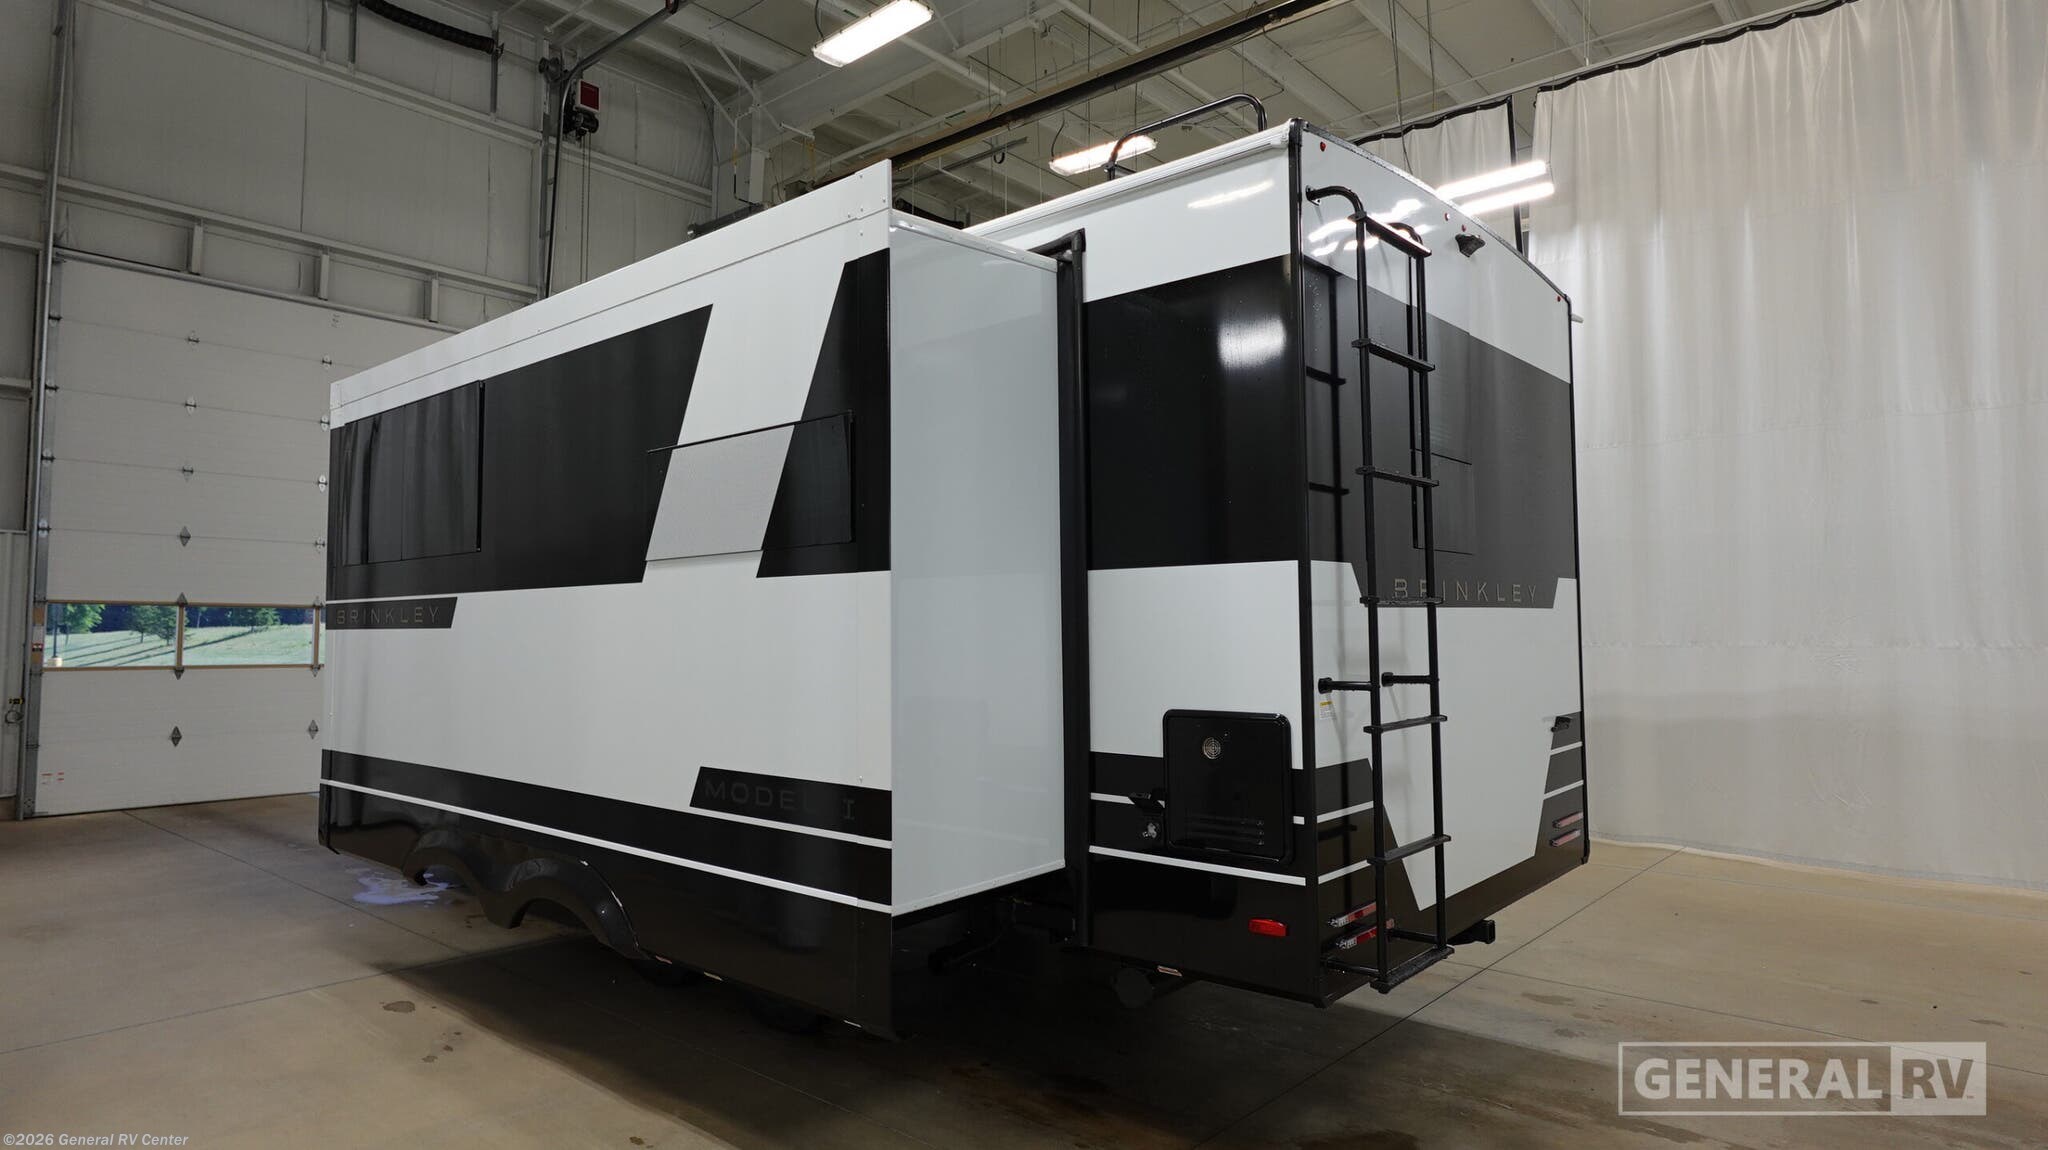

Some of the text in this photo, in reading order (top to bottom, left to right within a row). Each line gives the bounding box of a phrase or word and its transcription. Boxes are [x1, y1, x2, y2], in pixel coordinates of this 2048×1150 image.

[336, 606, 439, 624] BRINKLEY
[704, 780, 857, 821] MODEL I
